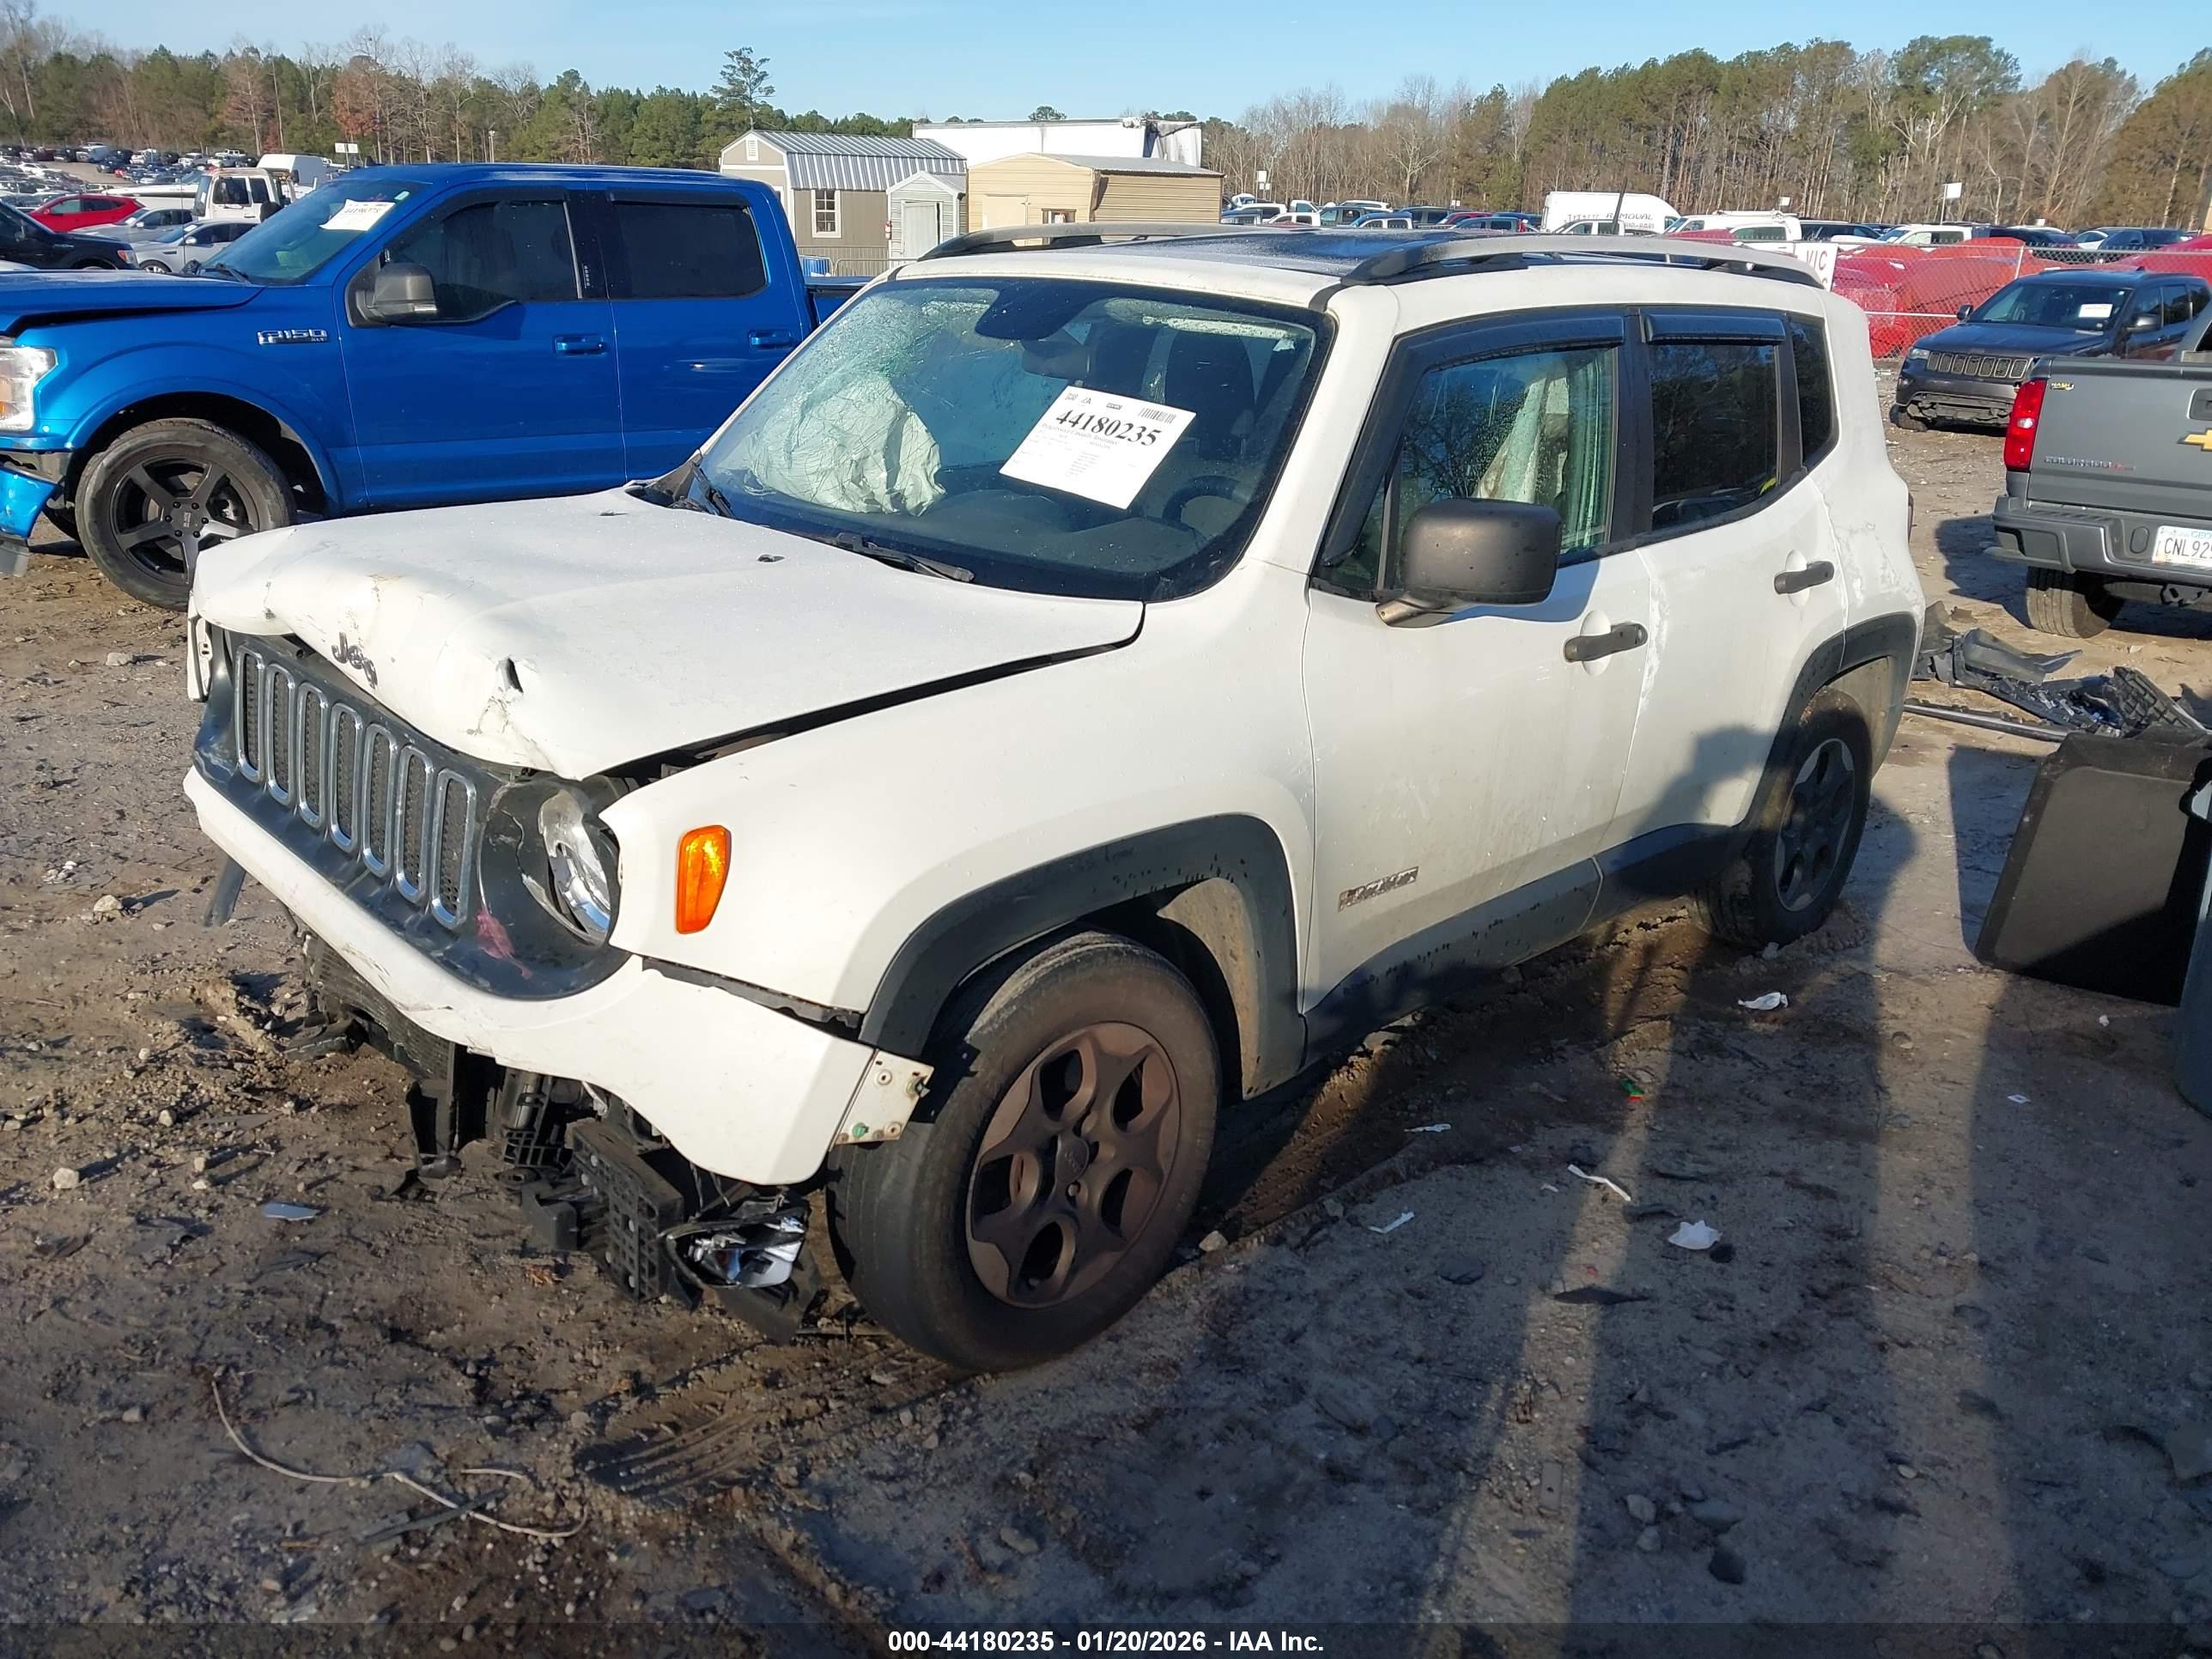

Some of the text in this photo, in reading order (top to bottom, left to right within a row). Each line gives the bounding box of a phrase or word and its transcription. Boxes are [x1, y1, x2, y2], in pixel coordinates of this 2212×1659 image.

[1606, 212, 1653, 221] RMOVAL
[1055, 409, 1162, 447] 44180235
[2164, 537, 2212, 559] CNL92
